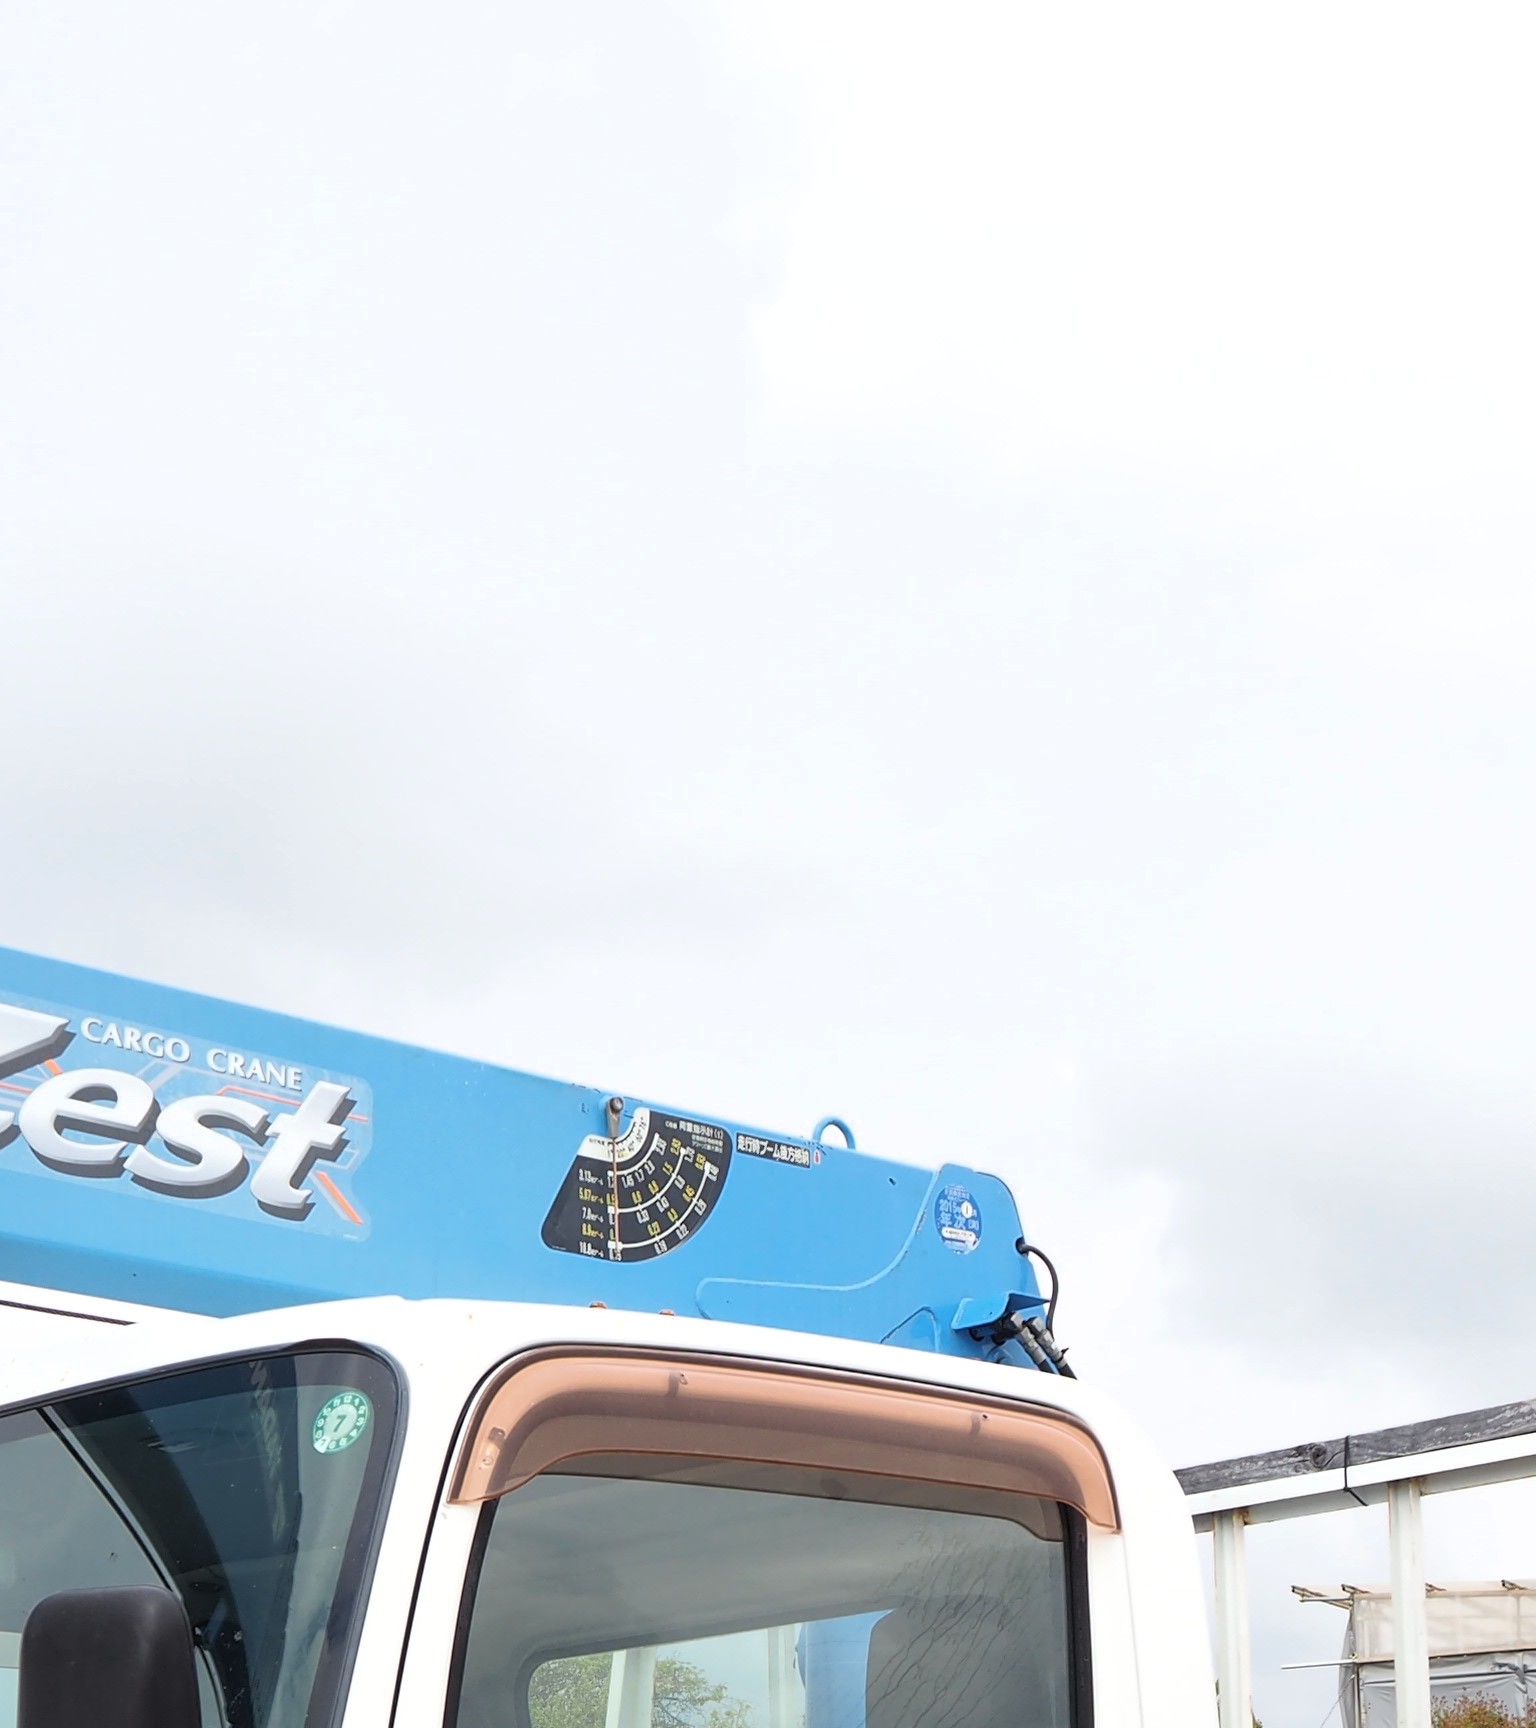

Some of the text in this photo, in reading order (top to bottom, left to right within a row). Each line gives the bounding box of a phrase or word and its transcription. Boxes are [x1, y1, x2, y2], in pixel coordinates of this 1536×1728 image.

[80, 1016, 303, 1092] CARGO CRANE
[333, 1414, 347, 1433] 7
